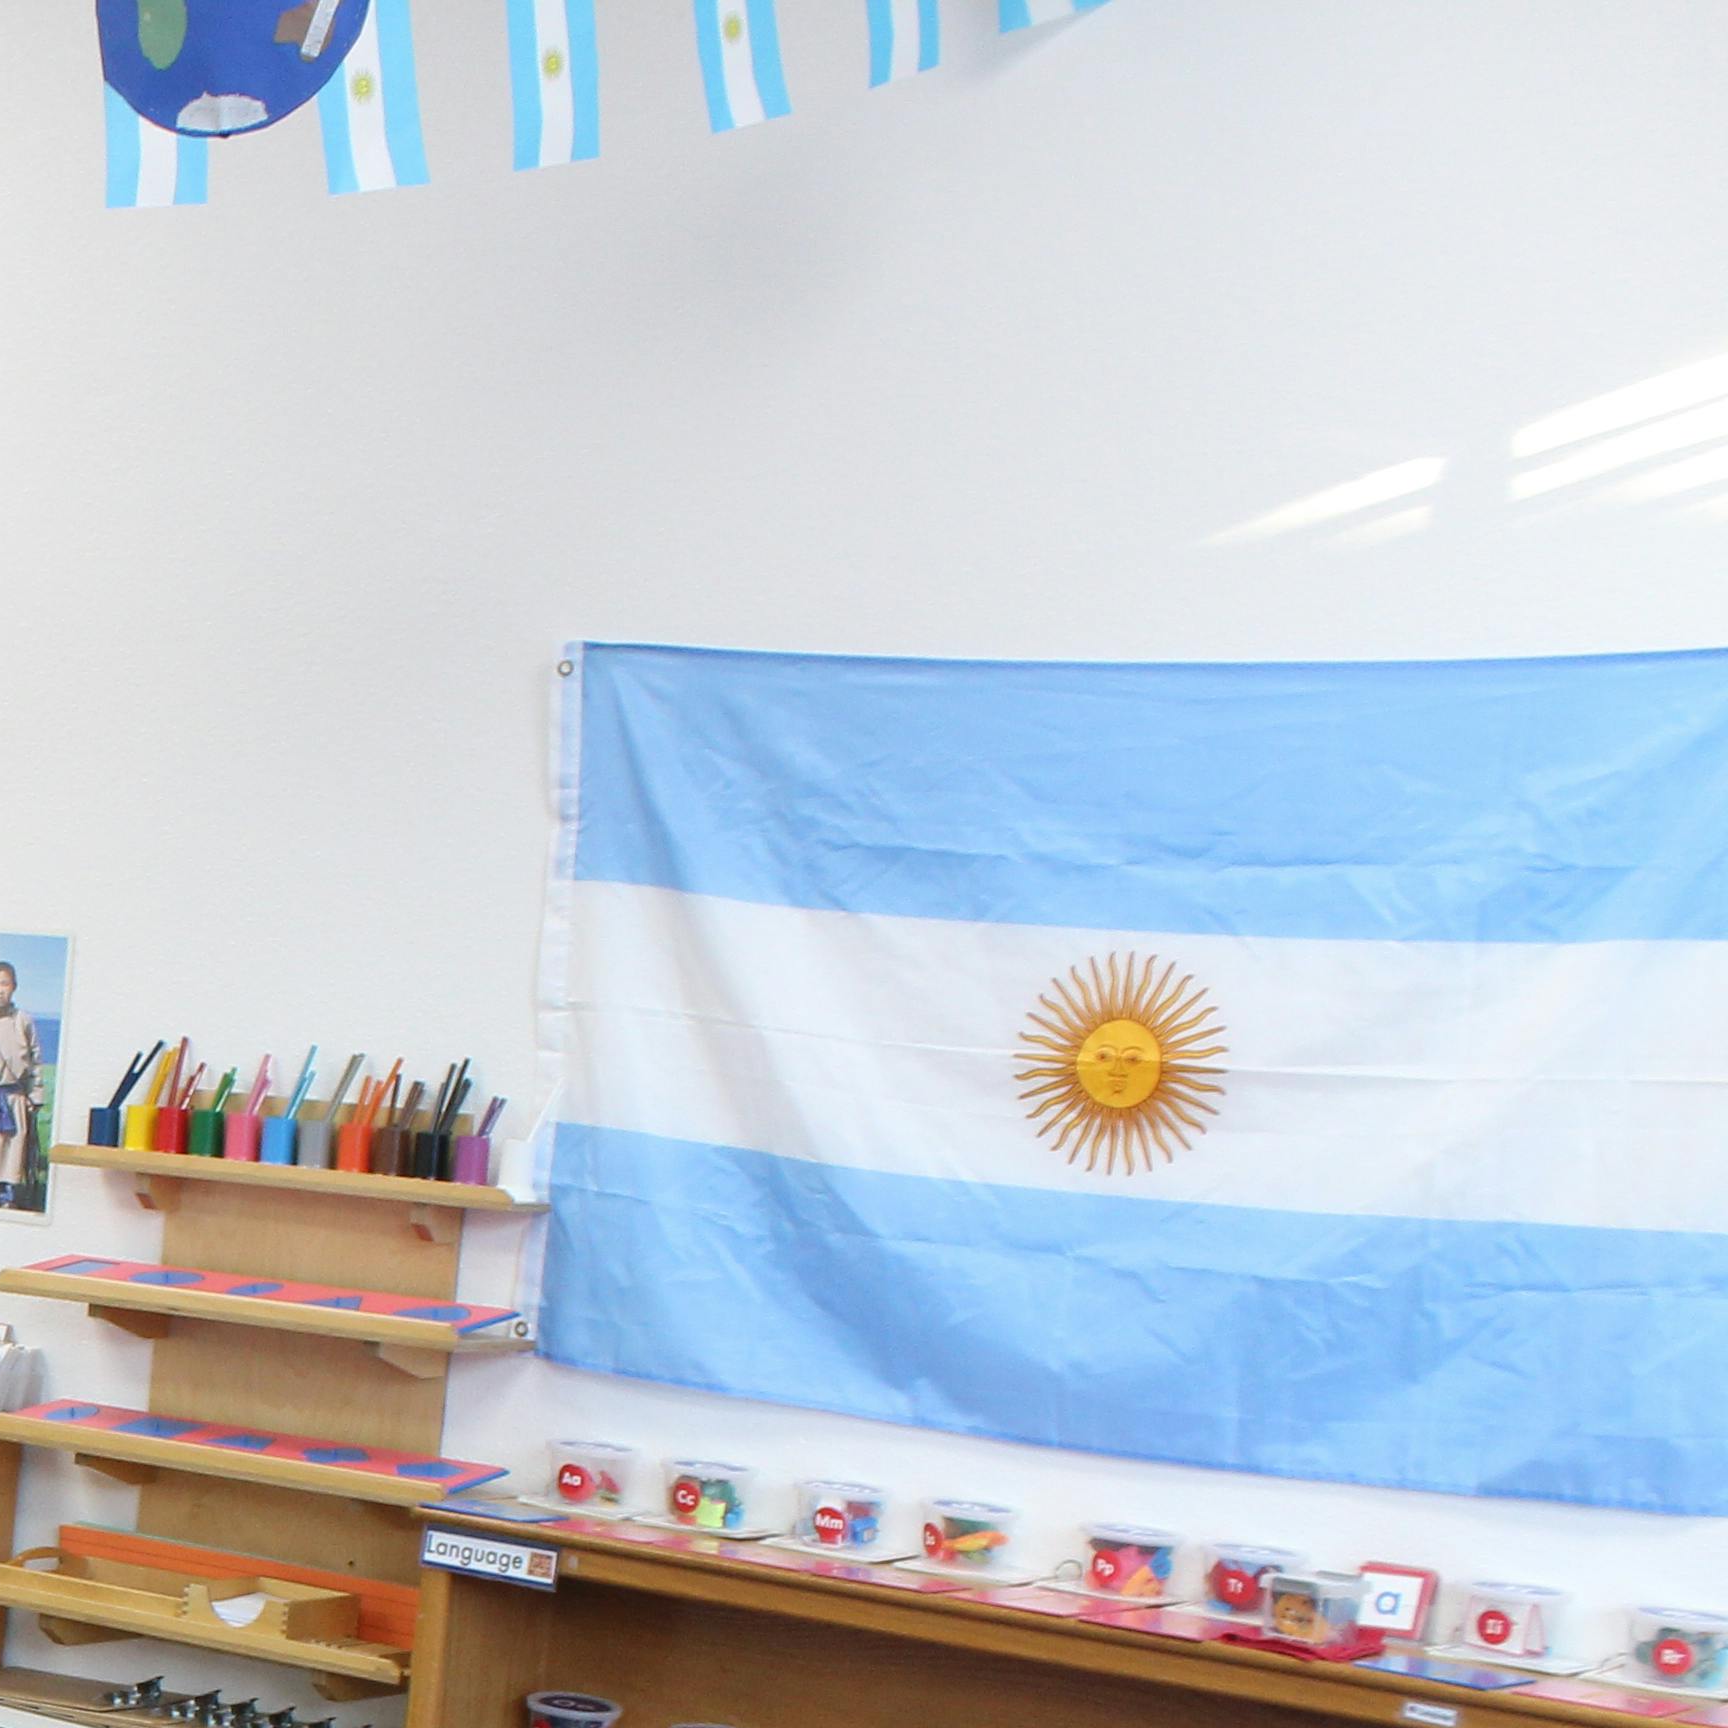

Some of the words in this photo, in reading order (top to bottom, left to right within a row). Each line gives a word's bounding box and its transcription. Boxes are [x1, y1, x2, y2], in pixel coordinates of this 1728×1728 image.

[562, 1471, 582, 1487] Aa
[676, 1489, 696, 1507] Cc
[815, 1513, 844, 1531] Mm
[425, 1532, 524, 1574] Language
[1094, 1557, 1115, 1577] Pp
[1376, 1591, 1402, 1616] a
